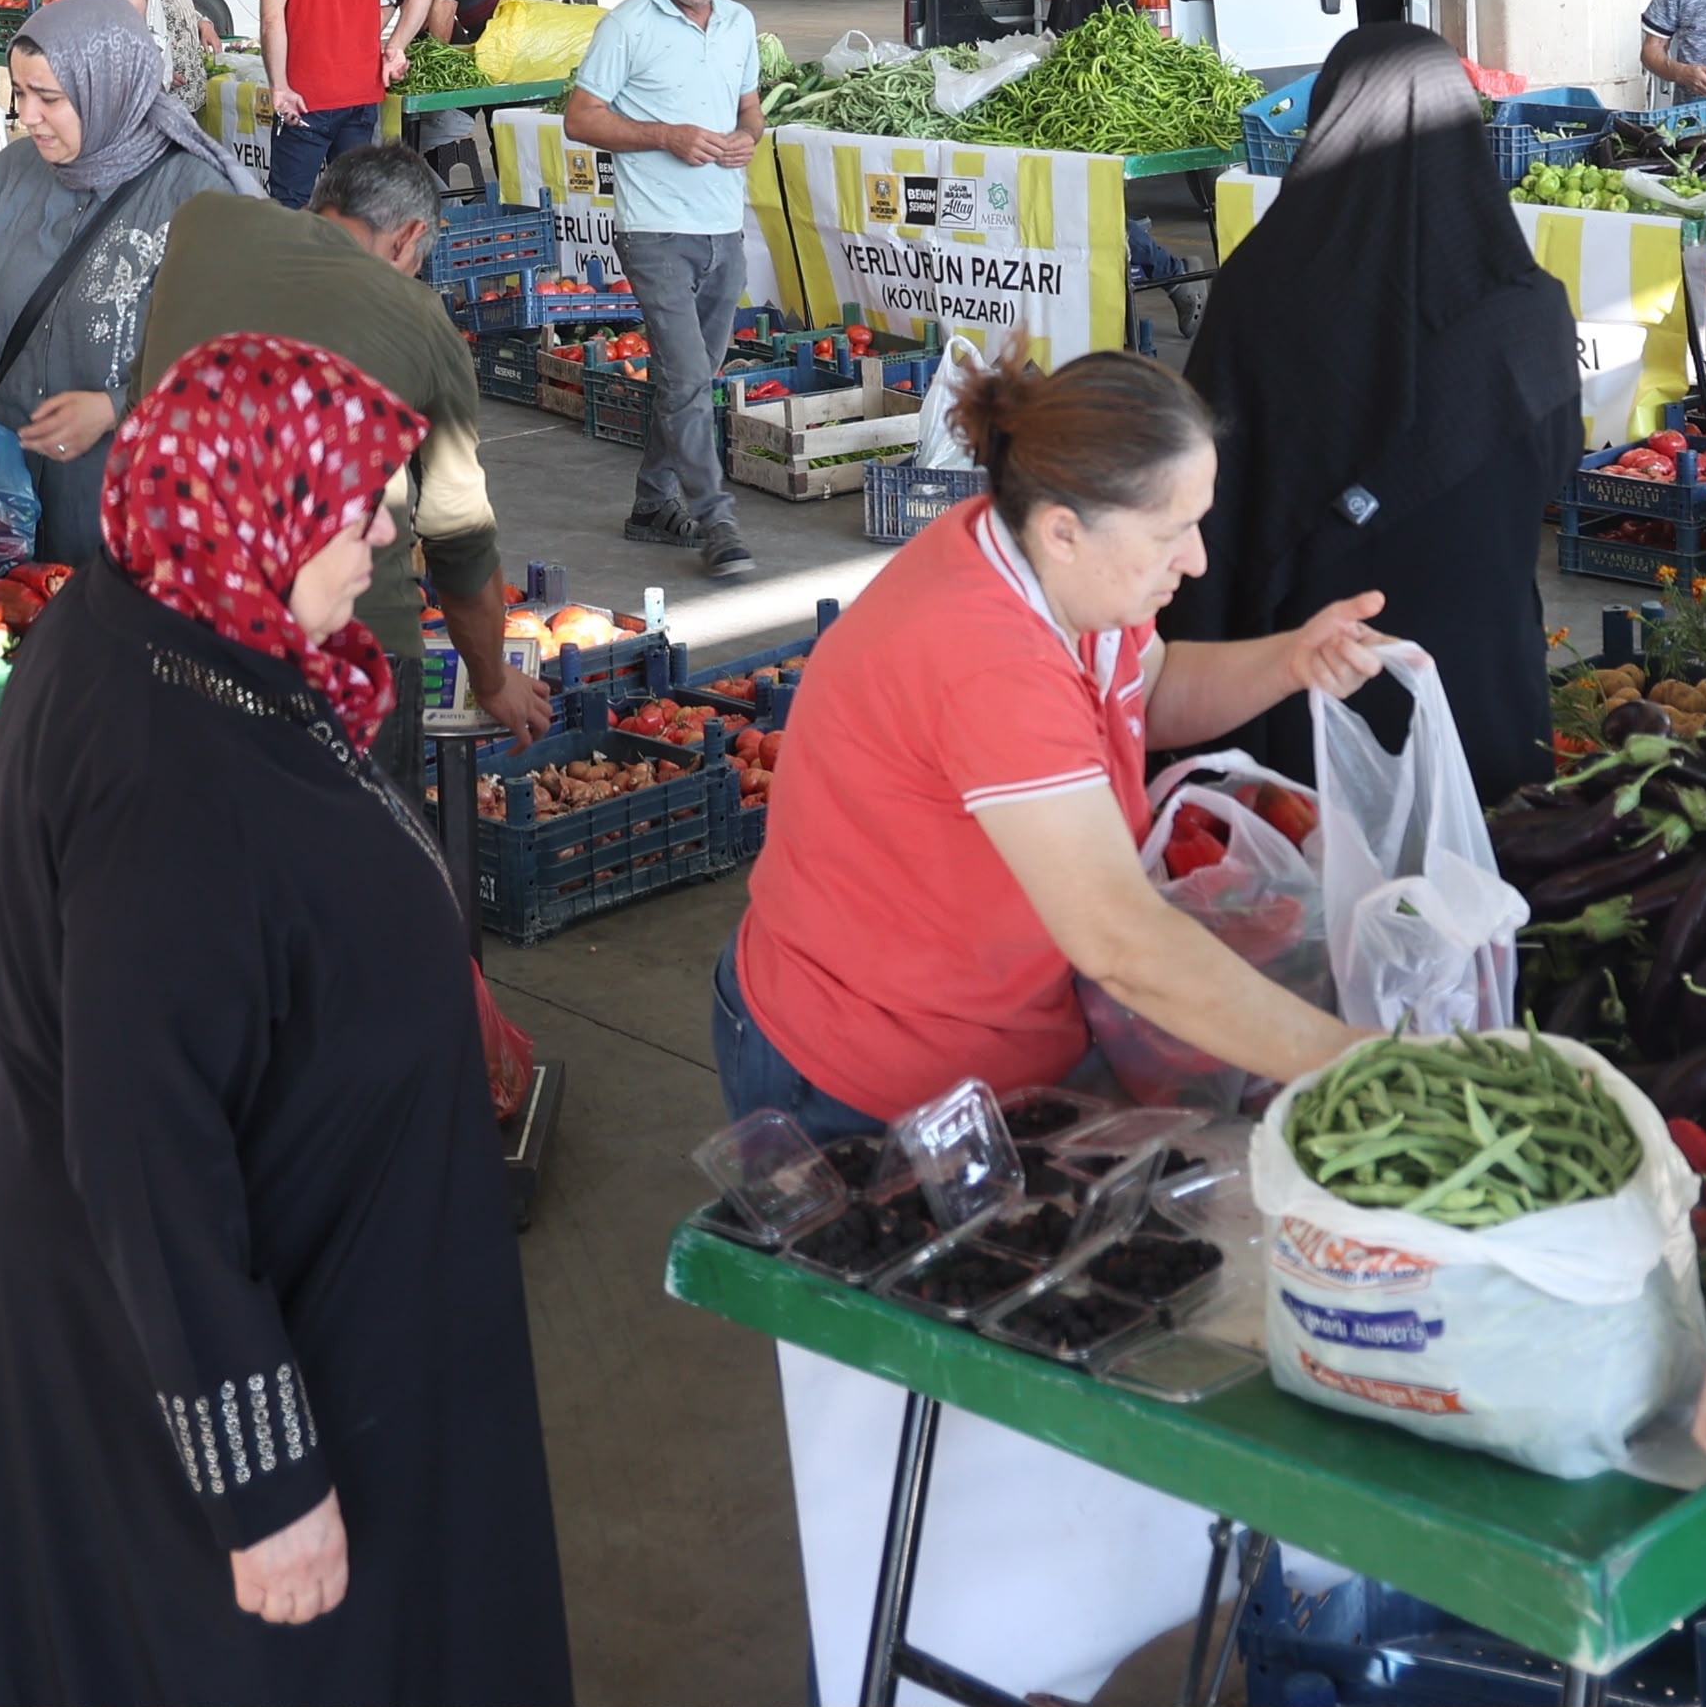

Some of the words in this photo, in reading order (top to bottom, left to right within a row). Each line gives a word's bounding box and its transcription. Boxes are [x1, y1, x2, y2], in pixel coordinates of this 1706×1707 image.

[233, 142, 270, 170] YERL
[554, 211, 593, 244] ERLİ
[980, 213, 1016, 226] MERAM
[841, 243, 902, 277] YERLİ
[904, 243, 963, 285] ÜRÜN
[971, 257, 1062, 295] PAZARI
[940, 296, 1016, 327] PAZARI)
